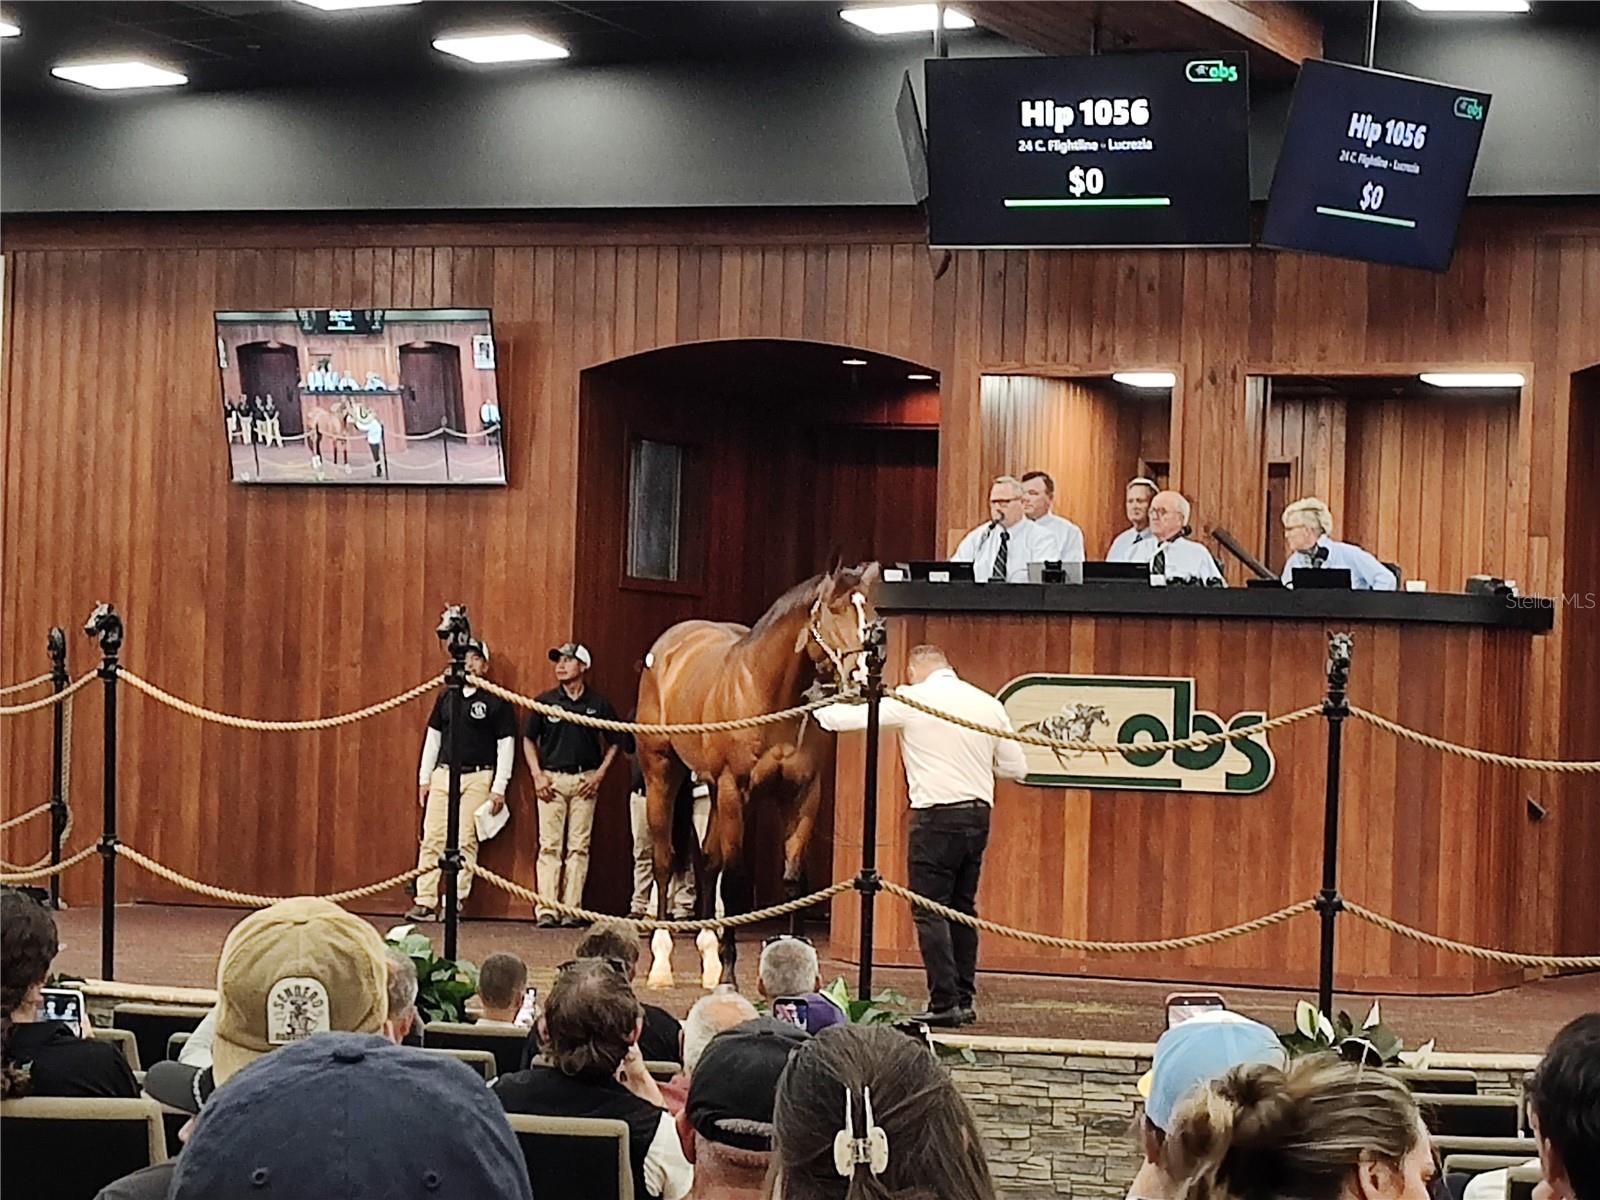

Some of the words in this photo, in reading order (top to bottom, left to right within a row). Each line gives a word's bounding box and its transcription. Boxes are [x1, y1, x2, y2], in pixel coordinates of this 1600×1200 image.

[1021, 100, 1075, 134] Hip
[1079, 98, 1150, 126] 1056
[1348, 112, 1382, 148] Hip
[1385, 118, 1427, 149] 1056
[1018, 139, 1033, 152] 24
[1069, 165, 1104, 197] $0
[1359, 181, 1384, 211] $0
[1117, 677, 1271, 790] obs
[273, 984, 324, 1010] SENDERO
